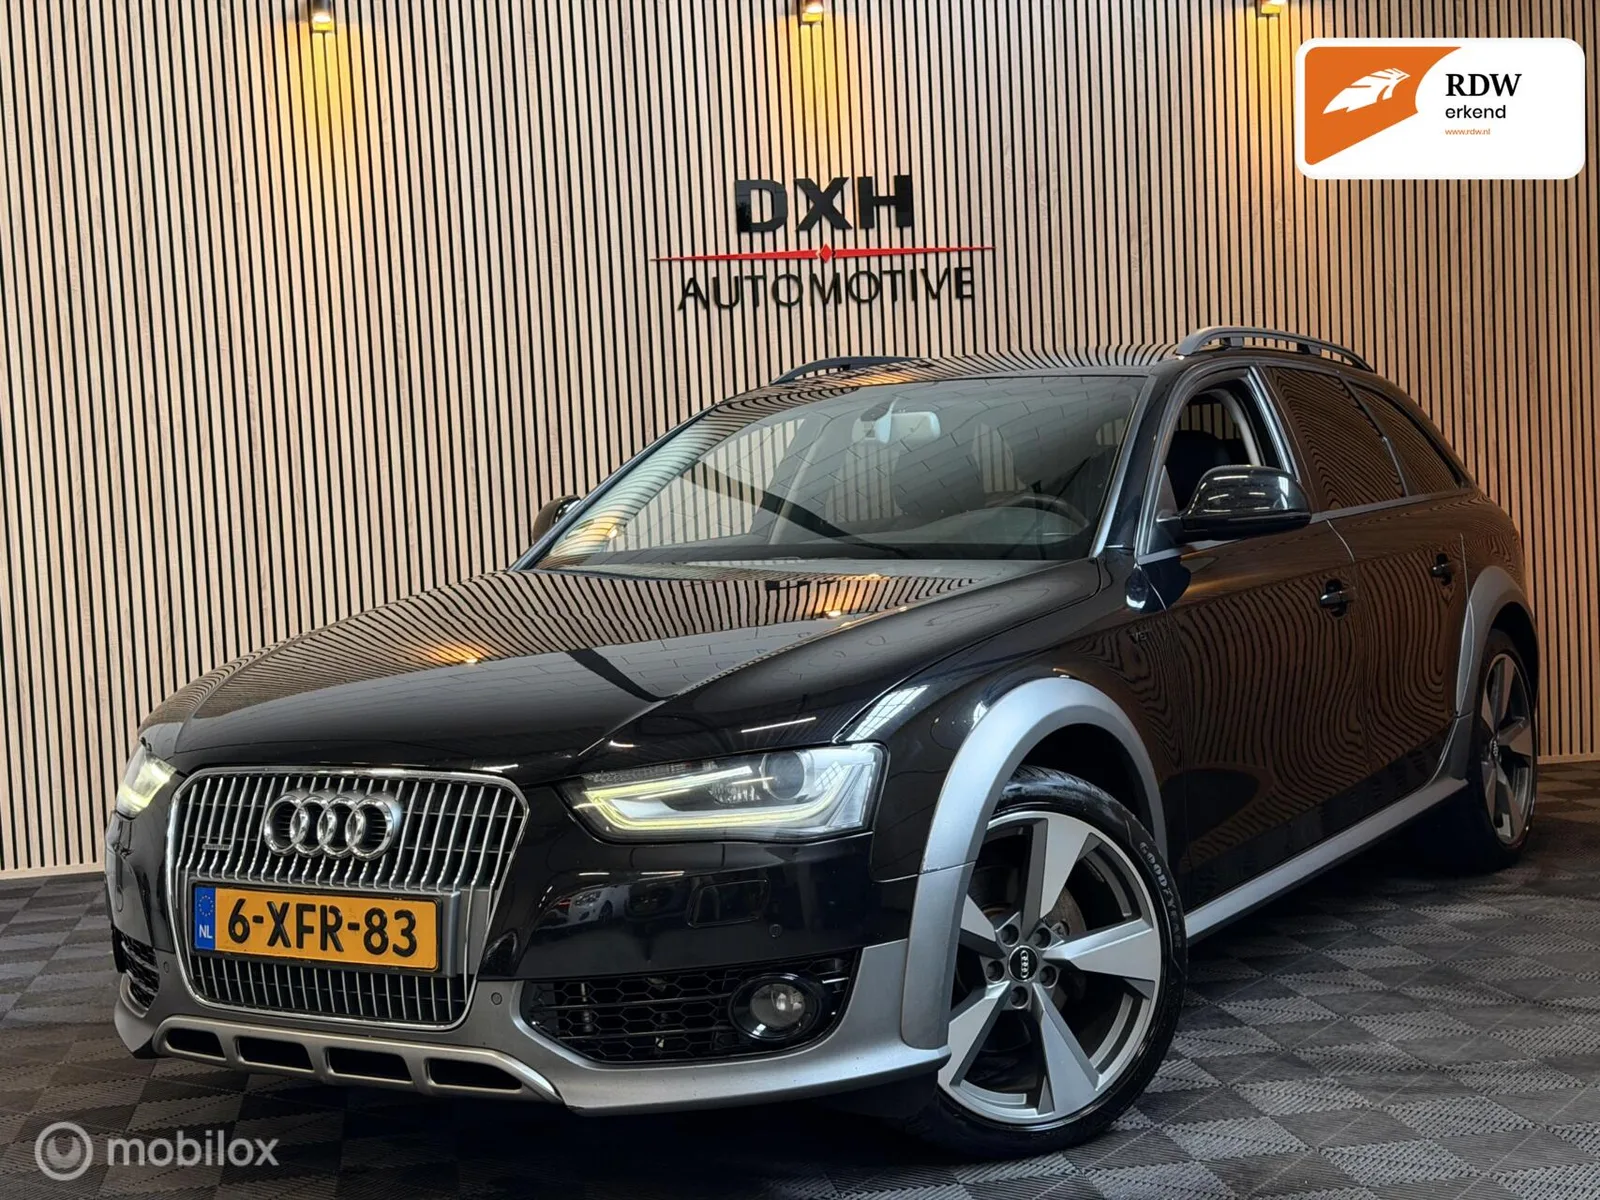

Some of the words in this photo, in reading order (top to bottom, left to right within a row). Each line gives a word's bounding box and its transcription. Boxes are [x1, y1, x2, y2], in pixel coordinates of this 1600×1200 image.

[735, 174, 914, 234] DXH
[677, 266, 975, 311] AUTOMOTIVE
[199, 924, 213, 940] NL
[227, 898, 418, 958] 6-XFR-83
